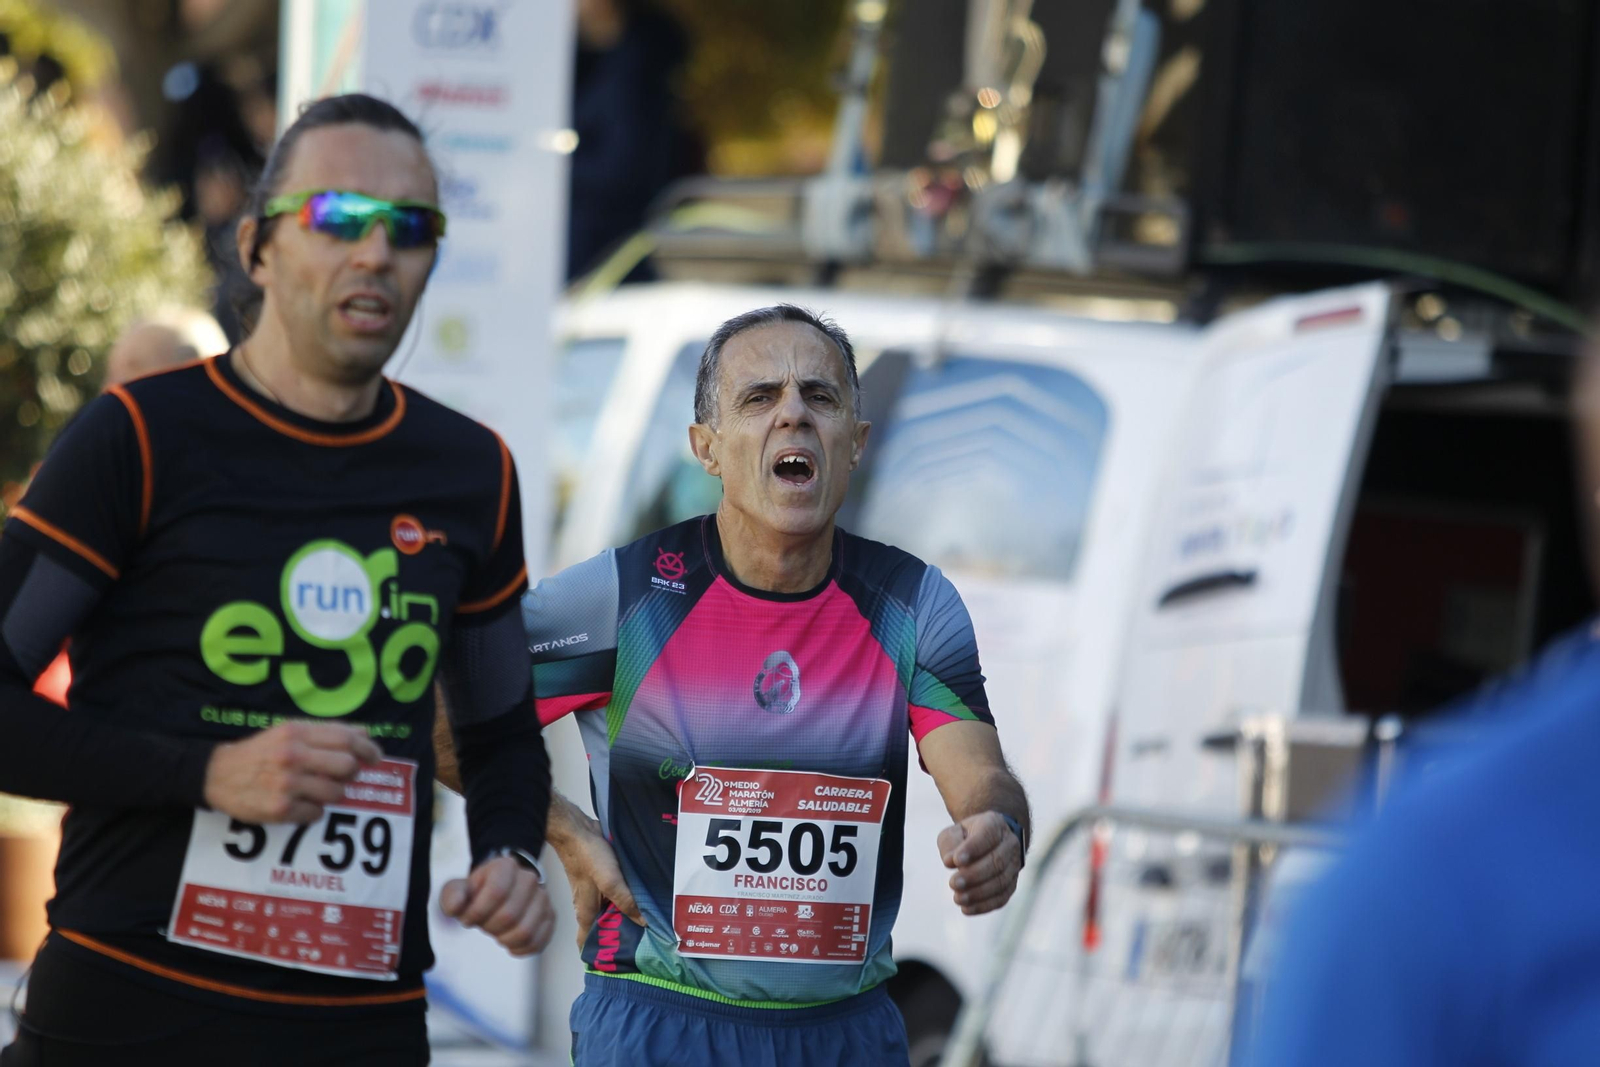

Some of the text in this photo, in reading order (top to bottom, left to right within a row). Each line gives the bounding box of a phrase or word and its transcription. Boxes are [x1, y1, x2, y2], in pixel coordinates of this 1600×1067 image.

[651, 576, 670, 587] BRK
[671, 581, 685, 590] 23
[296, 581, 366, 614] run
[200, 538, 440, 717] ego
[201, 705, 245, 726] CLUB
[729, 781, 760, 790] MEDIO
[814, 785, 874, 800] CARRERA
[728, 789, 775, 800] MARATÓN
[728, 798, 769, 809] ALMERÍA
[797, 799, 872, 814] SALUDABLE
[222, 811, 393, 878] 5759
[702, 818, 859, 878] 5505
[270, 868, 346, 893] MANUEL
[733, 874, 829, 893] FRANCISCO
[737, 891, 771, 899] FRANCISCO
[687, 903, 788, 915] NEXA CDX ALMERÍA
[686, 925, 714, 934] Blanes
[695, 941, 721, 949] cajamar
